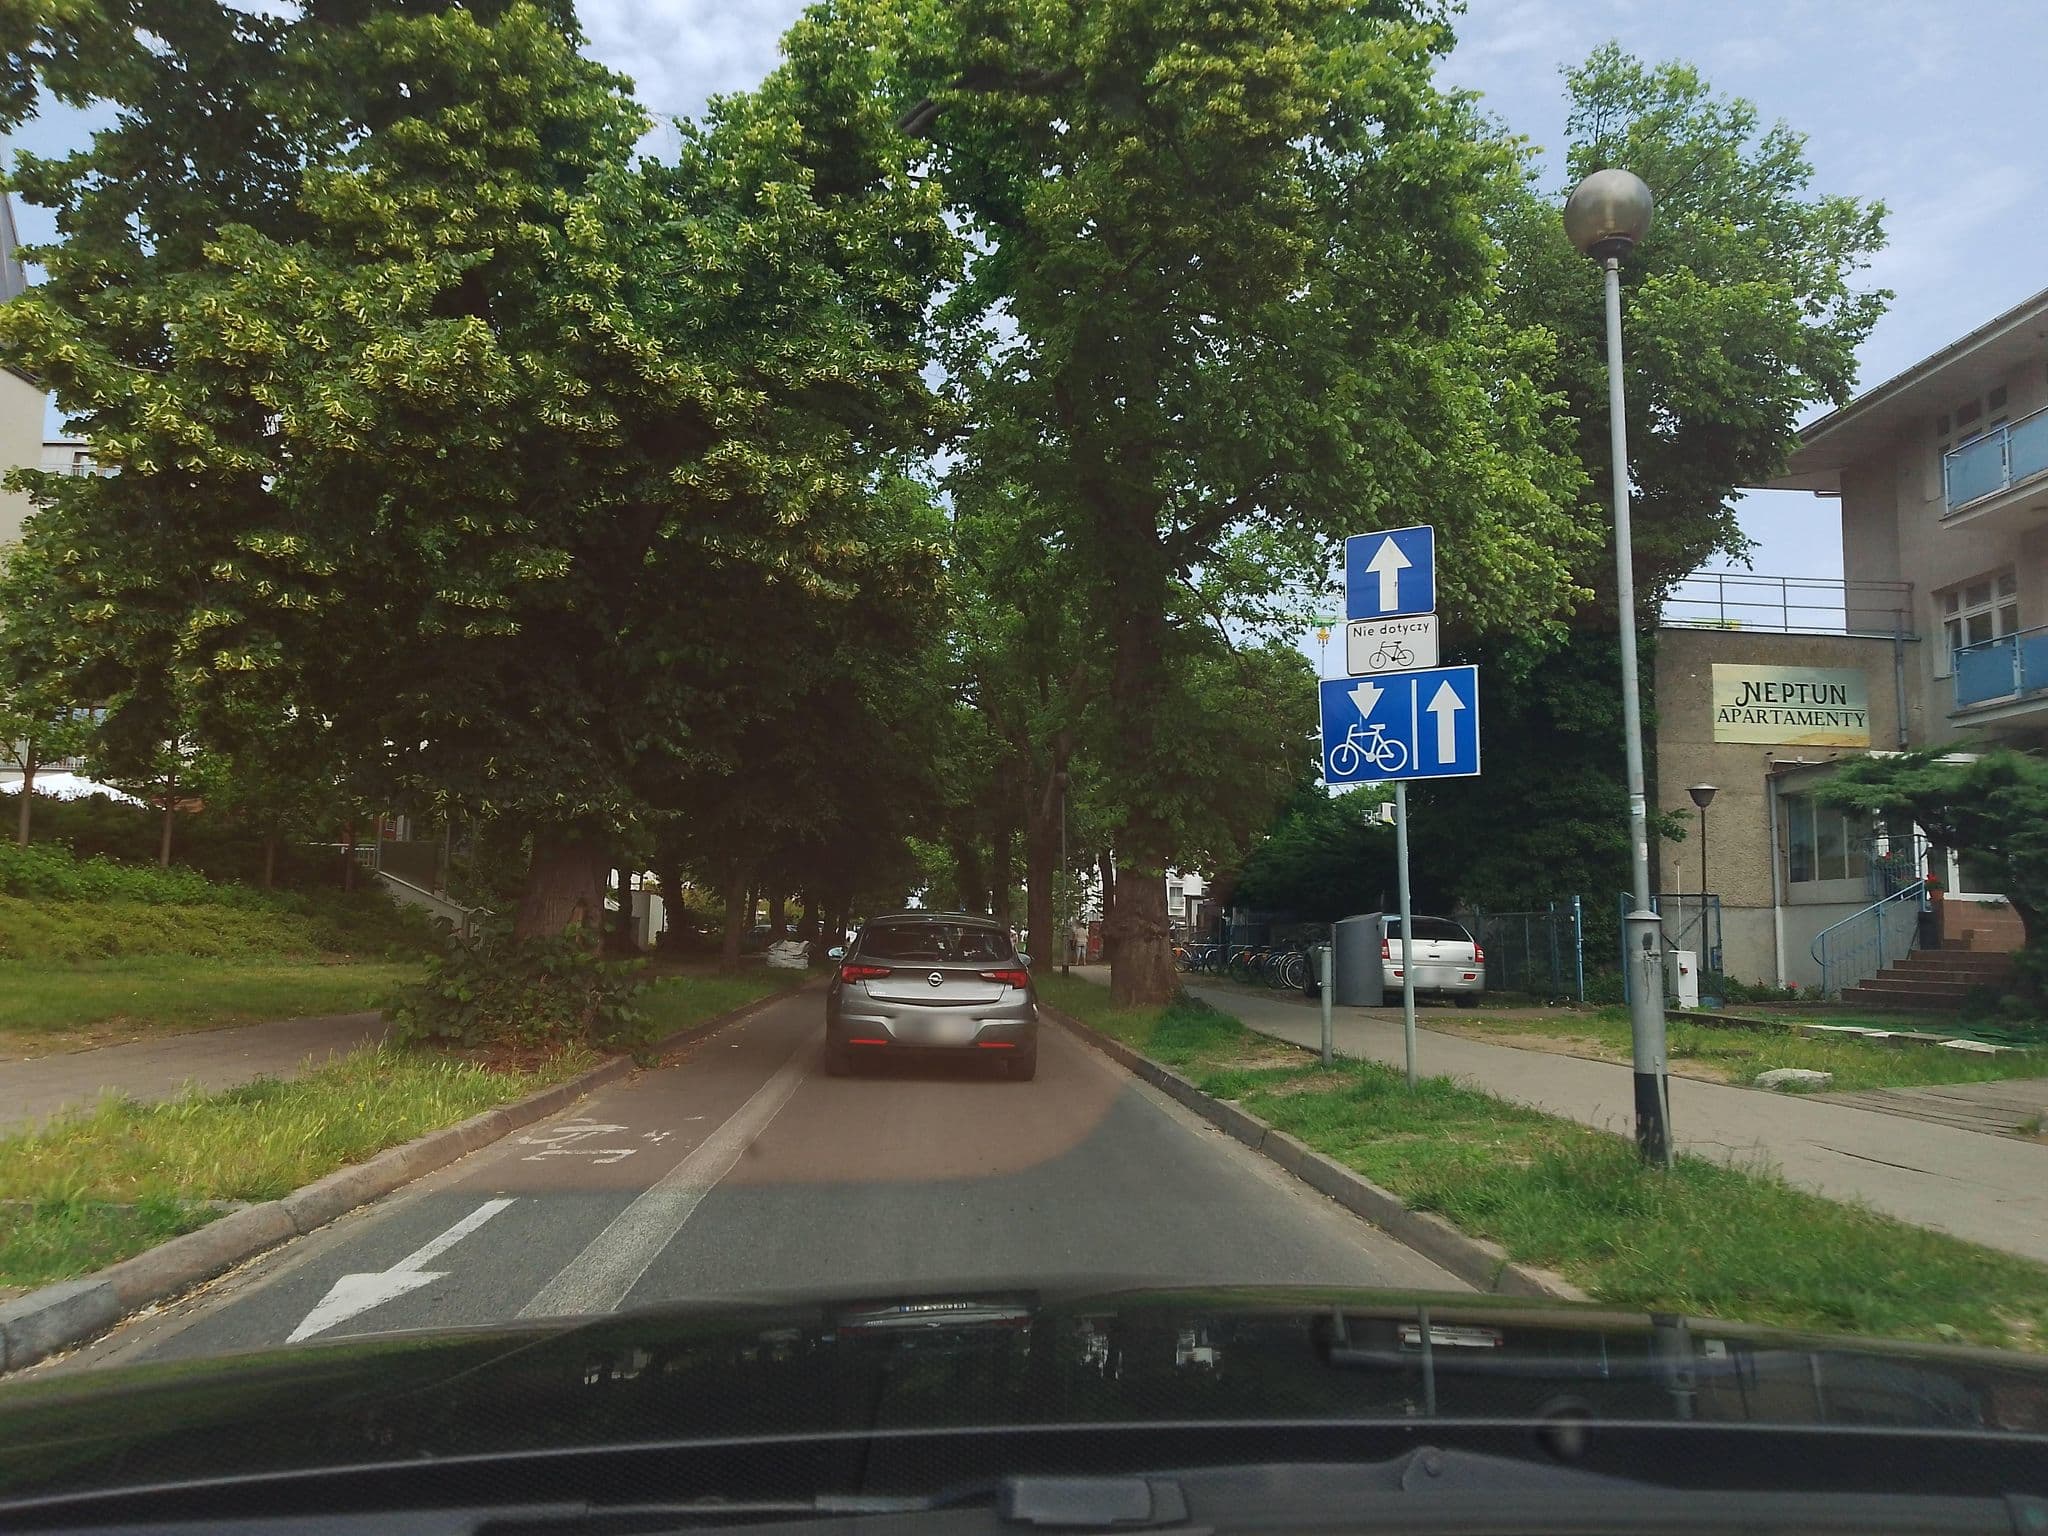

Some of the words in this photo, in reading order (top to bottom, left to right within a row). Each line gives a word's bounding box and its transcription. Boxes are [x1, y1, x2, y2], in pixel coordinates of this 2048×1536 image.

[1353, 626, 1375, 638] Nie
[1379, 622, 1430, 635] dotyczy
[1735, 681, 1847, 707] NEPTUN
[1717, 708, 1866, 727] APARTAMENTY
